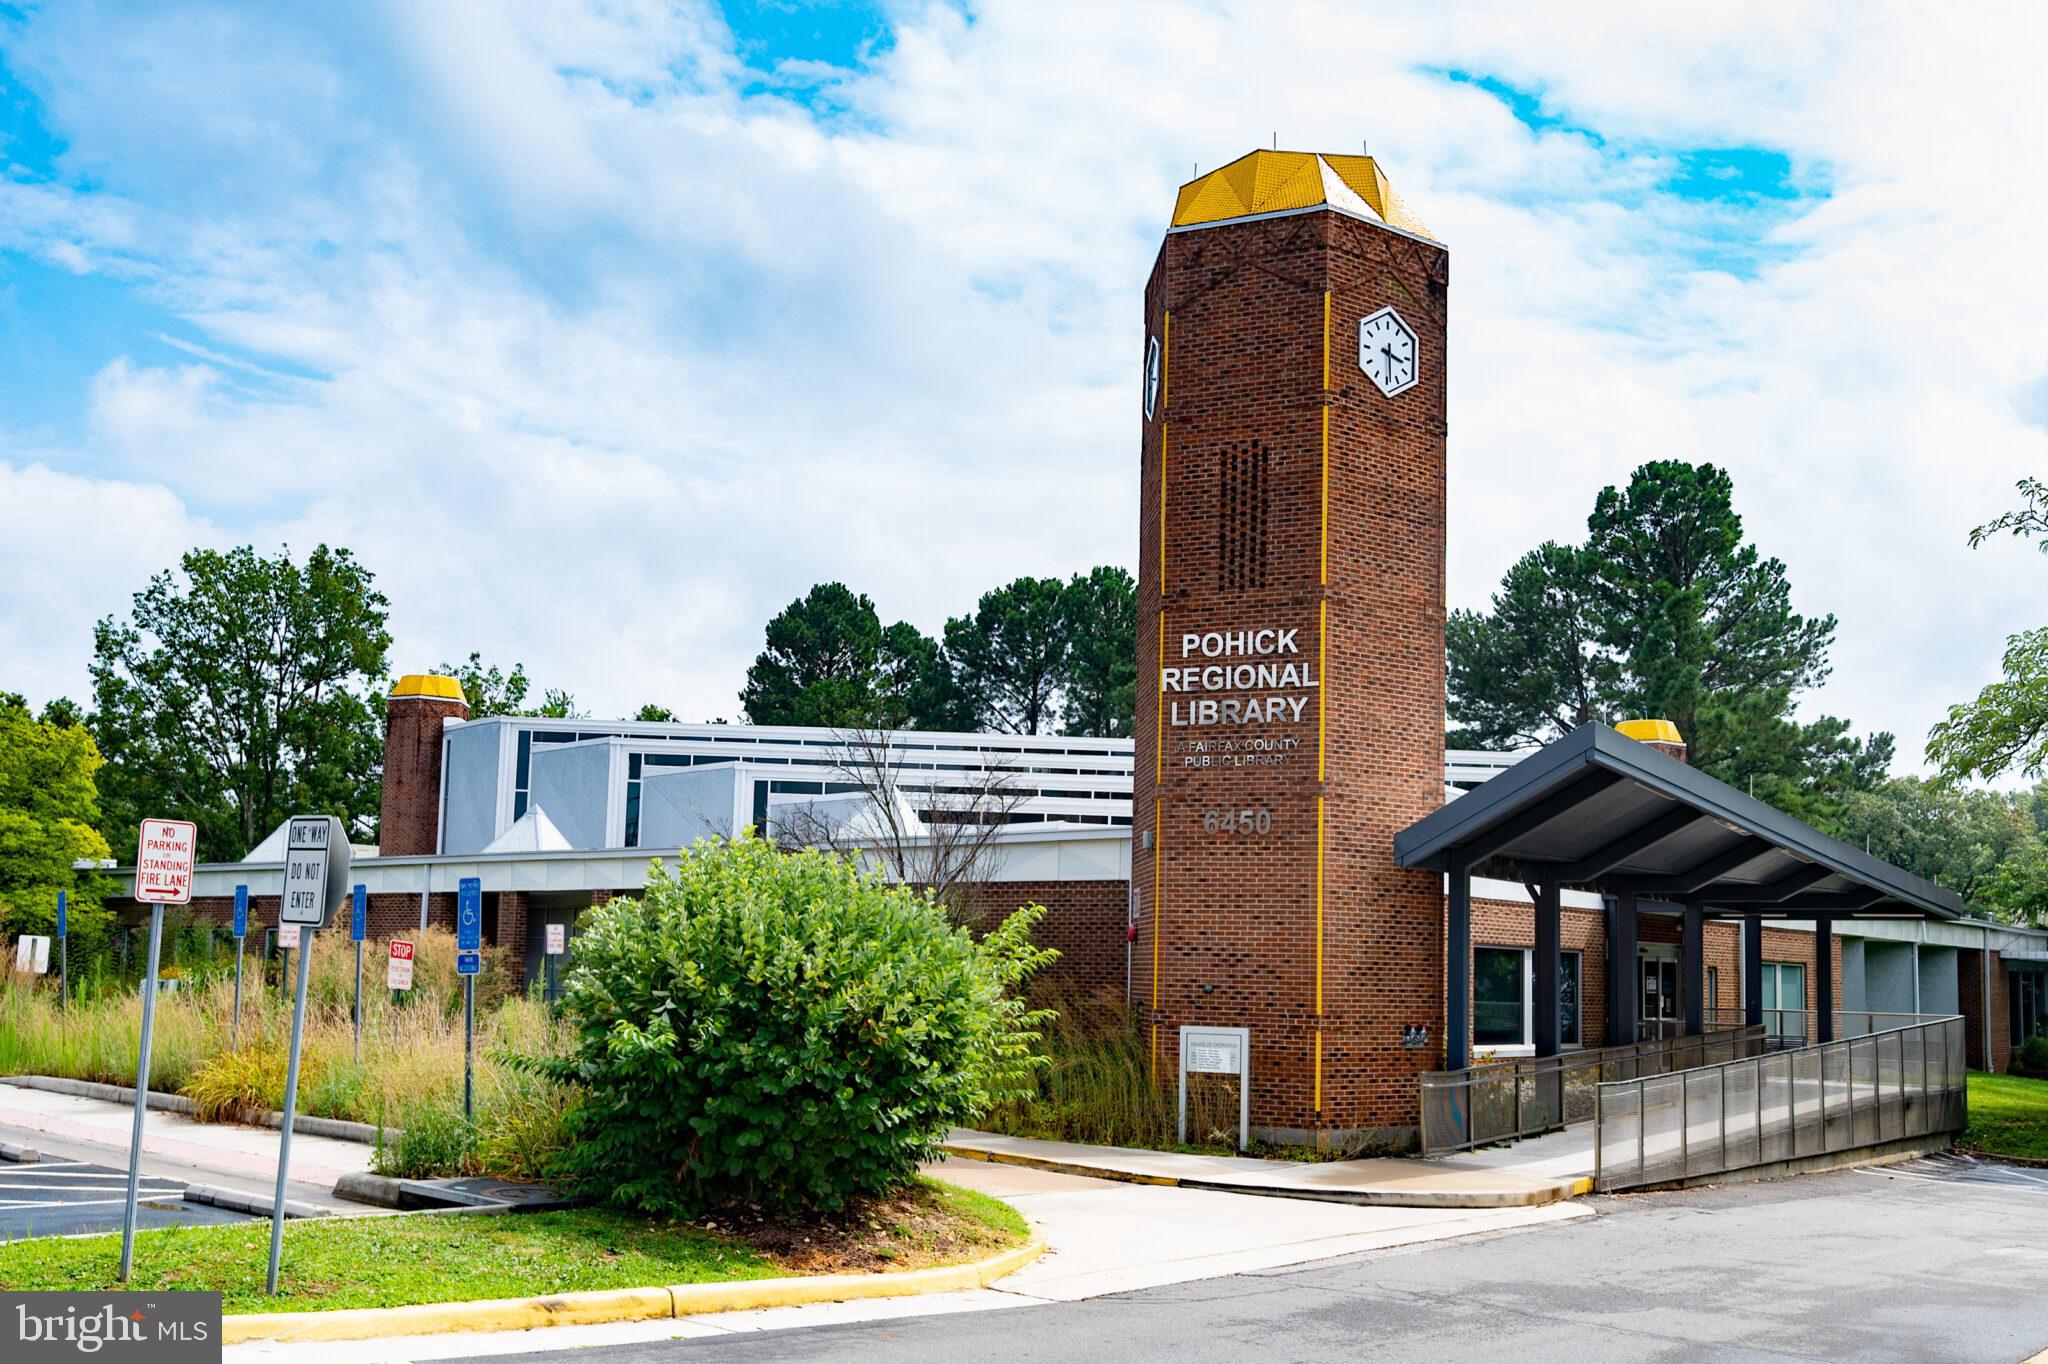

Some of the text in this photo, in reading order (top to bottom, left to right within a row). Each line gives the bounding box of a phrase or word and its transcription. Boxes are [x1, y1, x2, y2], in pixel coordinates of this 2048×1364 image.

[1182, 628, 1299, 658] POHICK
[1161, 662, 1320, 692] REGIONAL
[1171, 697, 1309, 726] LIBRARY
[1189, 741, 1242, 753] FAIRFAX
[1245, 739, 1300, 751] COUNTY
[1184, 754, 1292, 767] PUBLIC LIBRARY
[1204, 809, 1272, 836] 6450
[162, 827, 175, 838] NO
[291, 826, 327, 843] ONE WAY
[147, 840, 188, 852] PARKING
[143, 859, 189, 872] STANDING
[291, 863, 320, 880] DO NOT
[141, 872, 188, 887] FIRE LANE
[290, 892, 315, 909] ENTER
[392, 943, 411, 957] STOP
